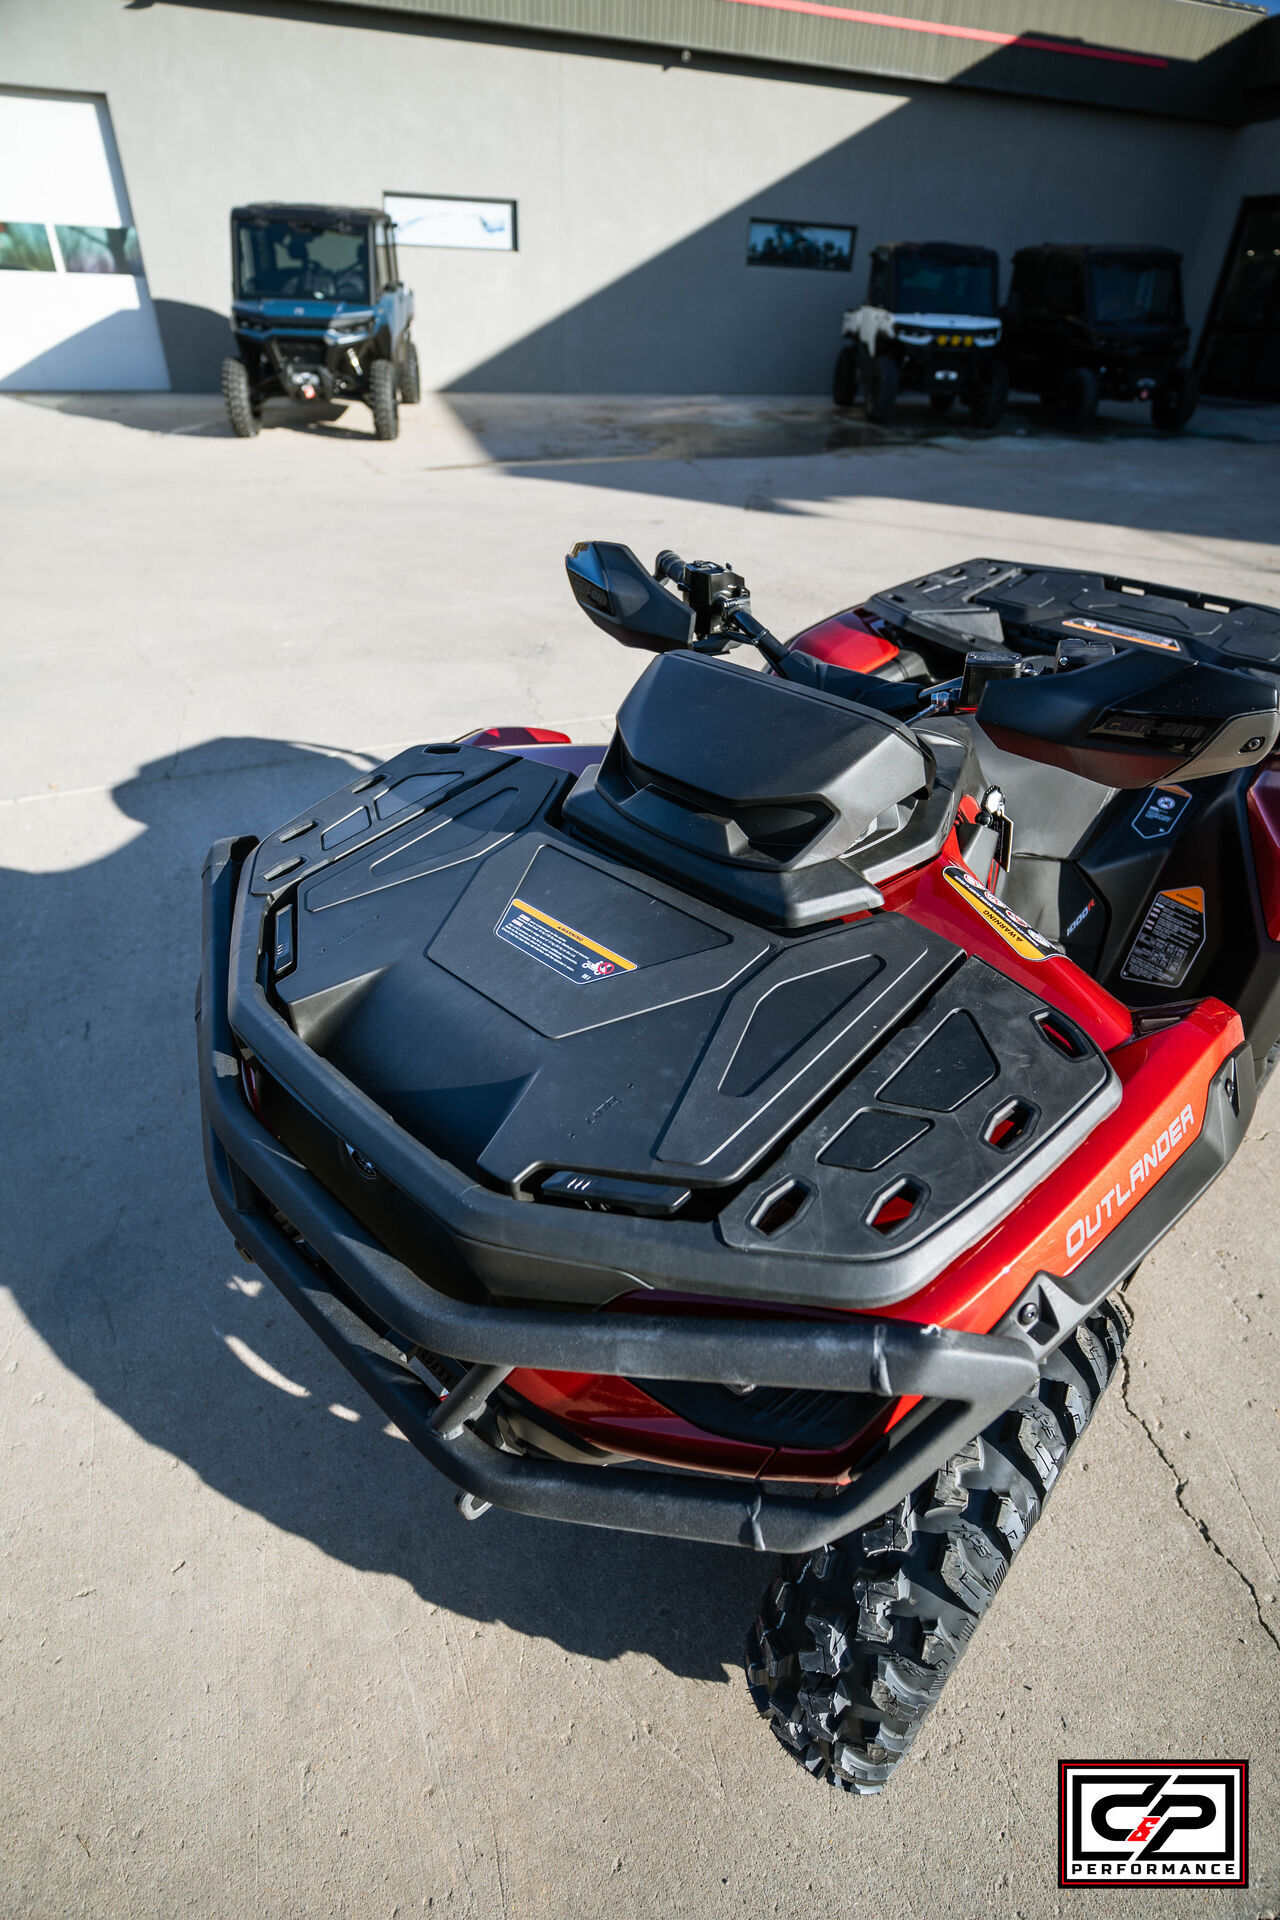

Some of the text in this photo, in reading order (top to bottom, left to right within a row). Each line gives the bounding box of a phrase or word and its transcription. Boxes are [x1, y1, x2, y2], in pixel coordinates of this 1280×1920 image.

[1103, 715, 1206, 739] can-am
[982, 909, 1017, 938] WARNING
[1066, 898, 1095, 936] 1000R
[1066, 1104, 1195, 1257] OUTLANDER
